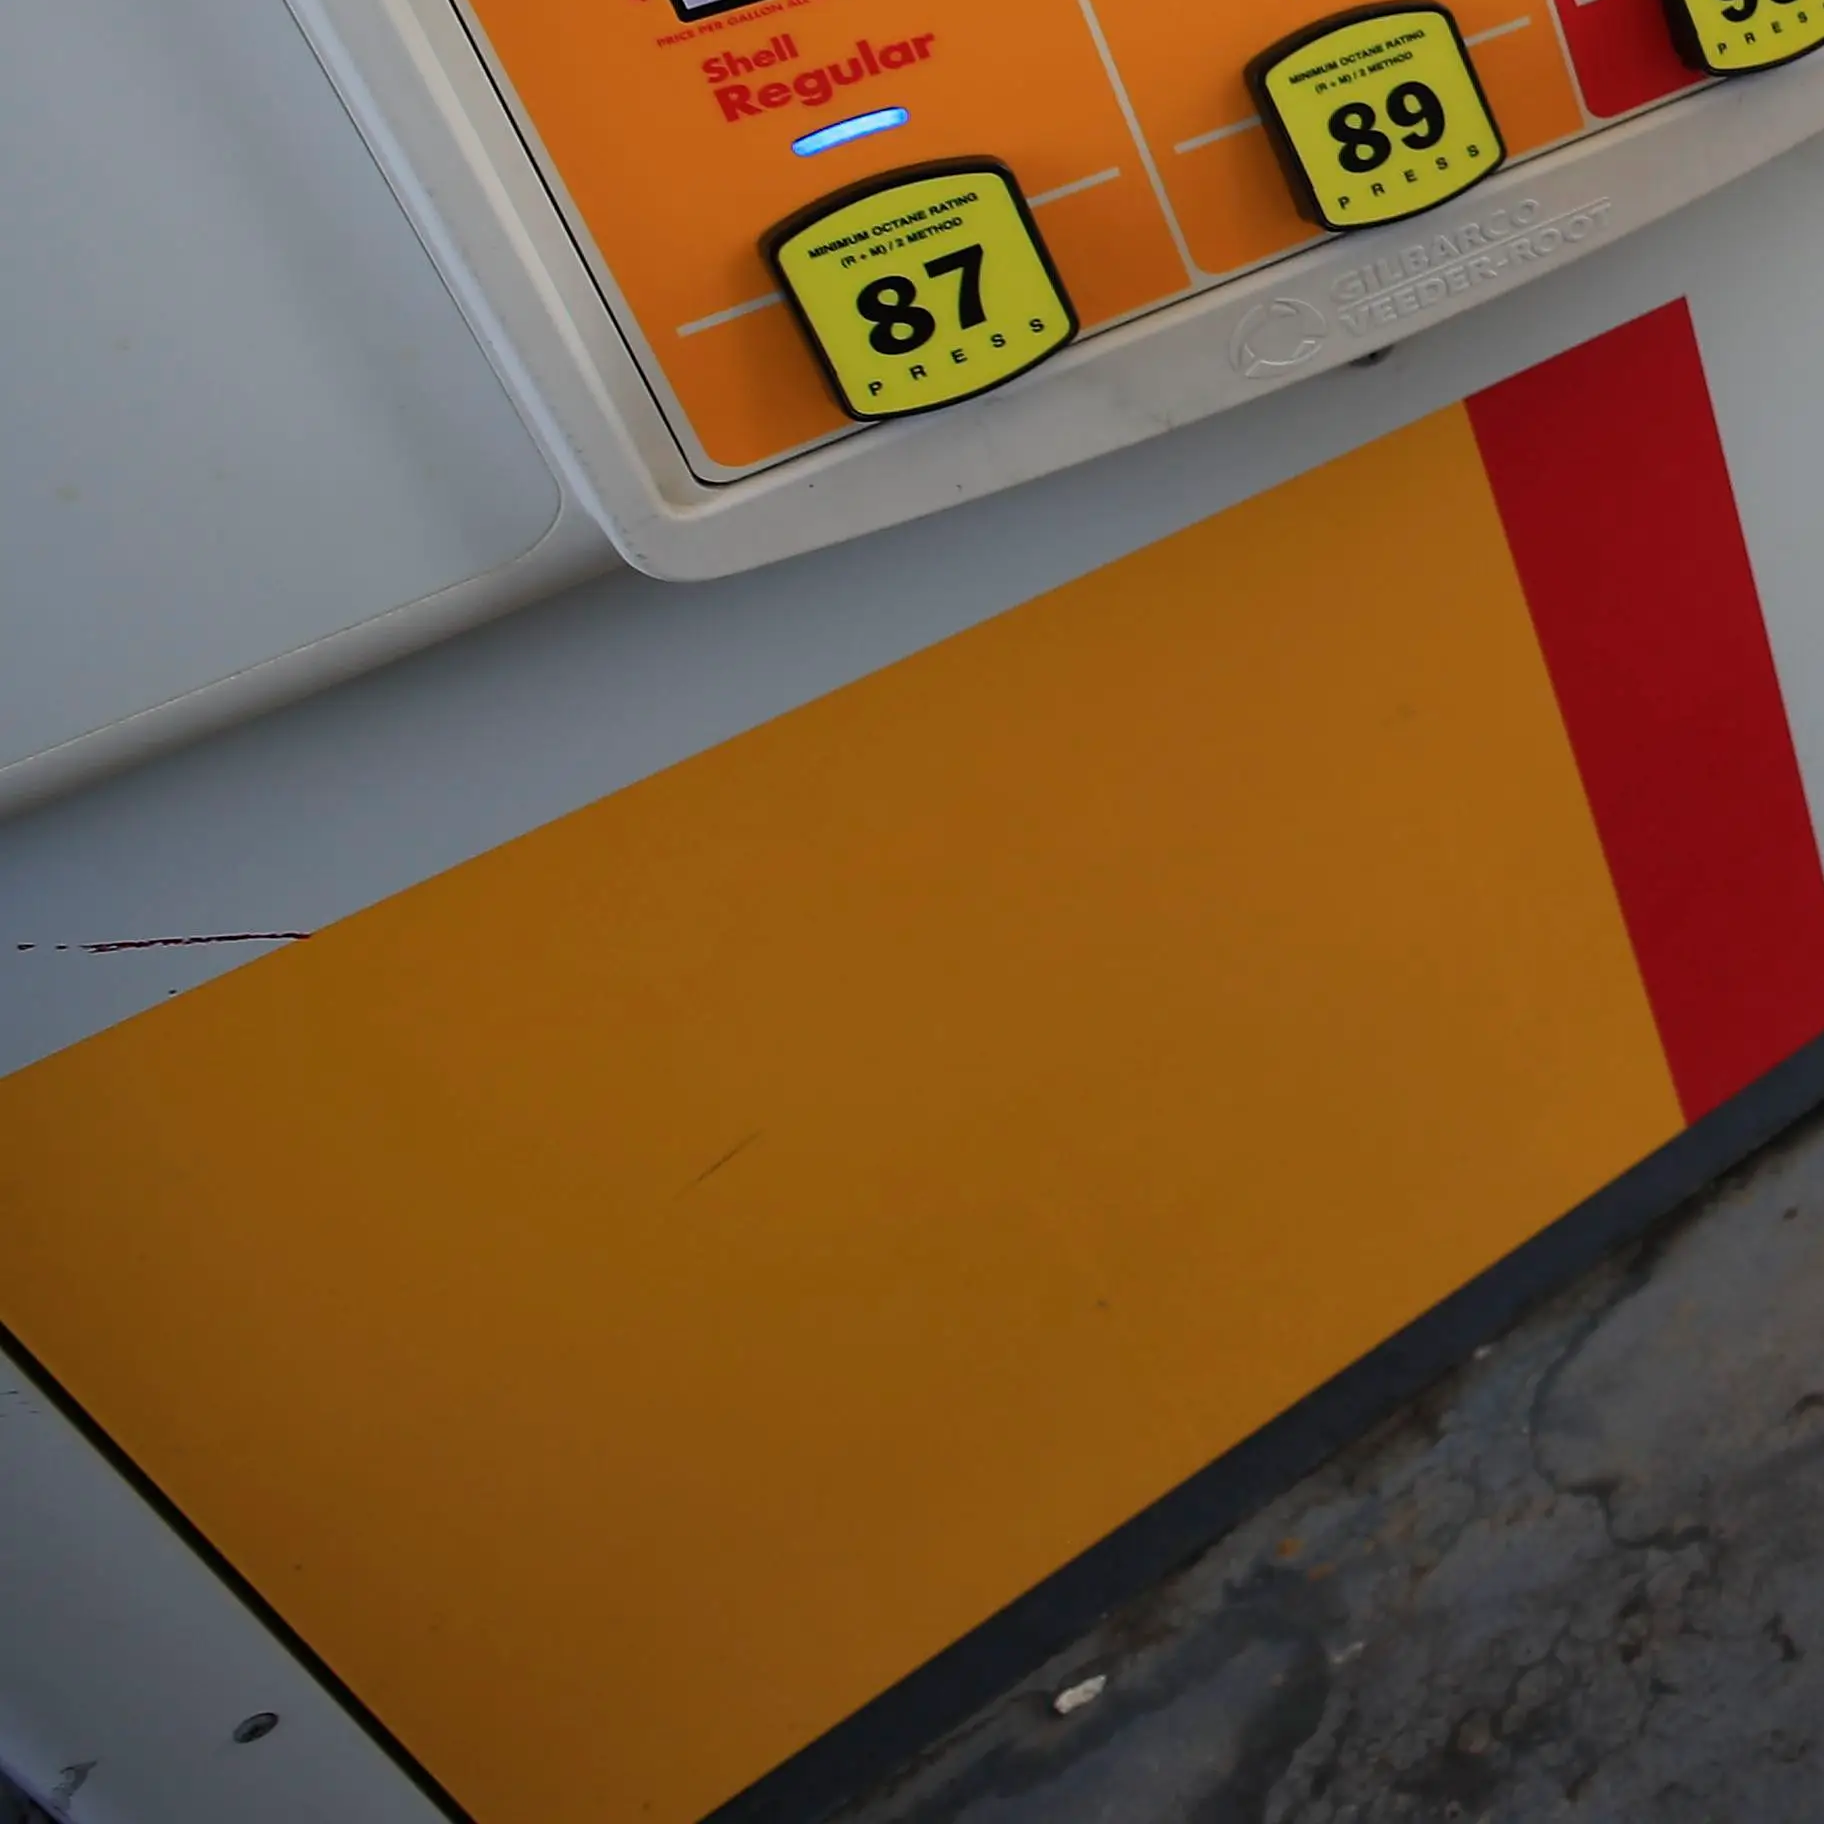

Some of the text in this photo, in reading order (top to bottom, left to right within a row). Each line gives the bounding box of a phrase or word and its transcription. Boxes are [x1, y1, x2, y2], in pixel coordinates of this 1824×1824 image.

[656, 29, 695, 49] PRICE
[698, 20, 724, 36] PER
[727, 2, 785, 27] GALLON
[701, 33, 799, 84] Shell
[1289, 29, 1426, 85] MINIMUM OCTANE RATING
[713, 32, 936, 123] Regular
[1315, 80, 1328, 95] (R
[1338, 72, 1353, 85] M)
[1368, 50, 1414, 75] METHOD
[1327, 80, 1446, 174] 89
[808, 192, 979, 259] MINIMUM OCTANE RATING
[840, 254, 857, 269] (R
[870, 243, 887, 259] M)
[907, 216, 963, 244] METHOD
[1330, 197, 1541, 301] GILBARCO
[856, 243, 988, 356] 87
[1339, 201, 1613, 336] VEEDER-ROOT
